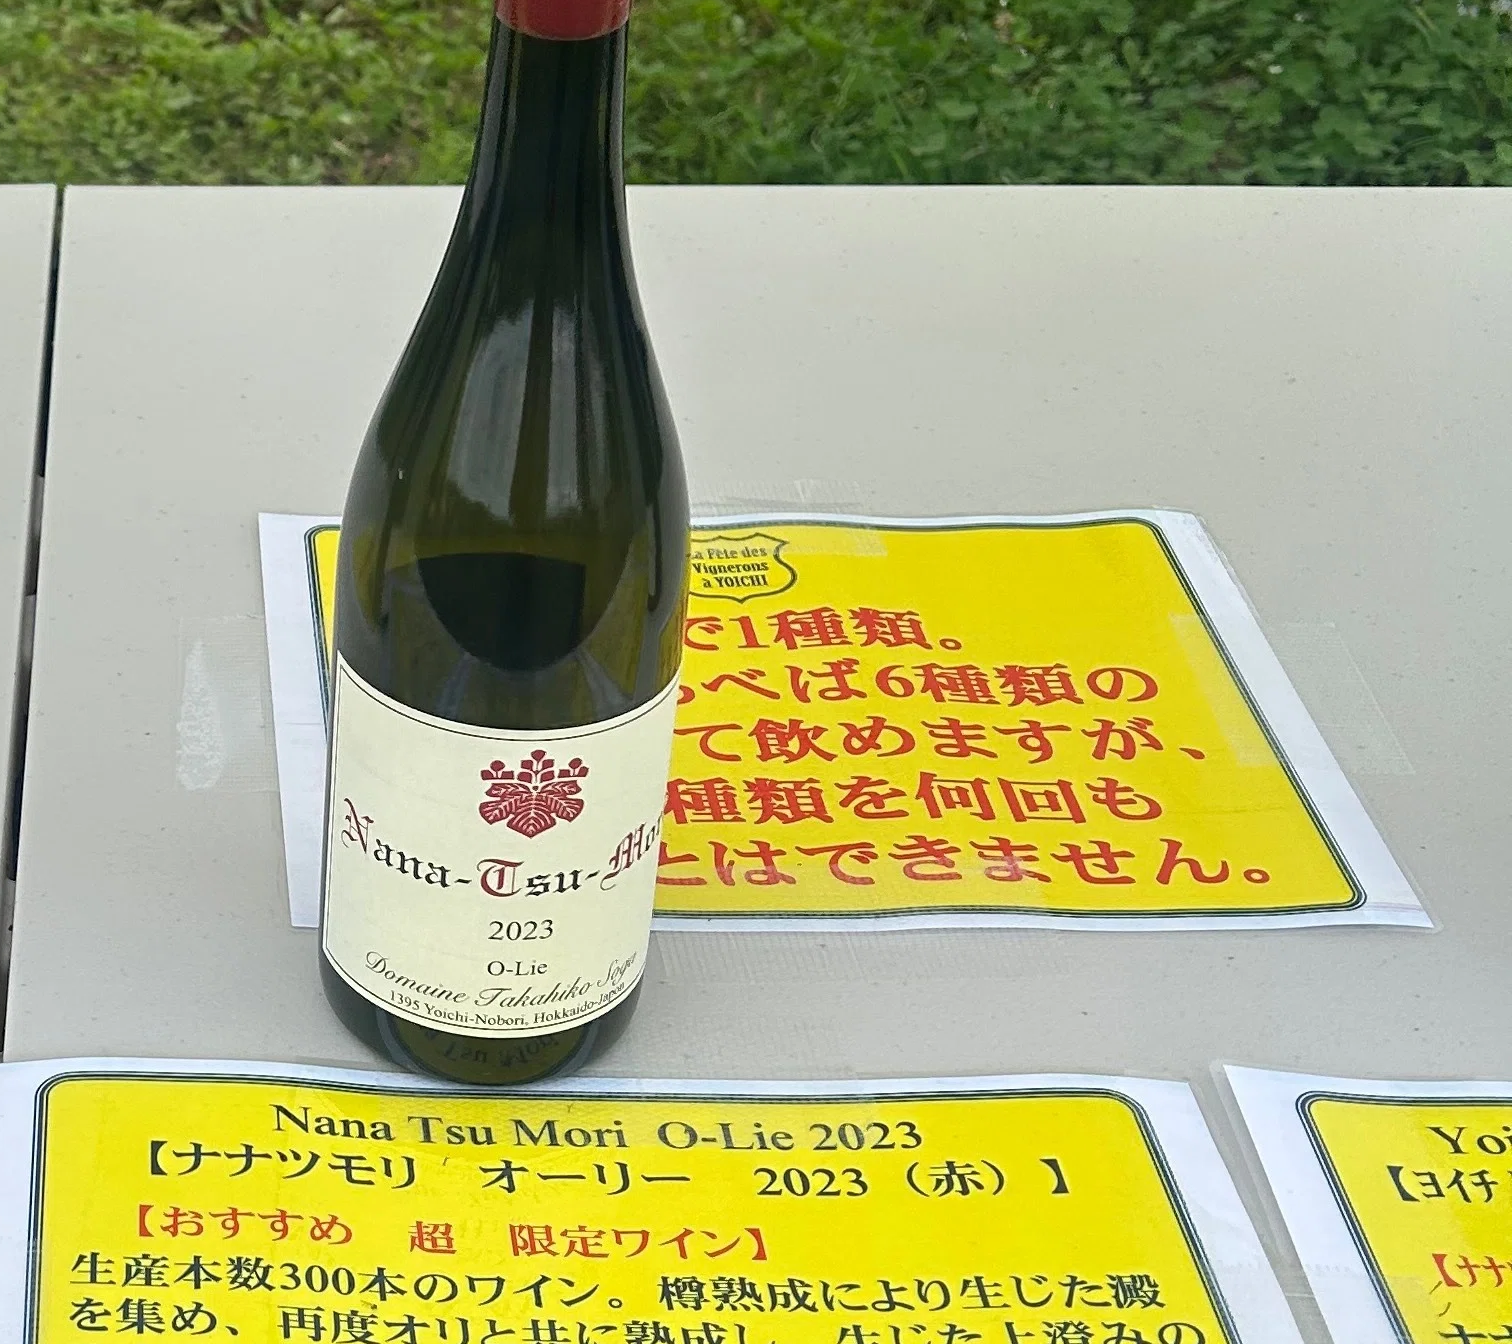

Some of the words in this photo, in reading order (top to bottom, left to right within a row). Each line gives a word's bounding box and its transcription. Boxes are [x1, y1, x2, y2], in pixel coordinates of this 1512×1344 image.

[692, 562, 769, 575] Vignerons
[714, 574, 768, 588] YOICHI
[488, 919, 554, 942] 2023
[365, 950, 470, 1004] Domaine
[473, 976, 595, 1008] Takahiko
[487, 959, 548, 977] O-Lie
[388, 989, 421, 1011] 1395
[270, 1103, 395, 1142] Nana
[407, 1114, 493, 1146] Tsu
[511, 1118, 630, 1149] Mori
[657, 1120, 796, 1152] O-Lie
[811, 1120, 923, 1152] 2023
[480, 1158, 692, 1195] オーリー
[409, 1221, 456, 1256] 超
